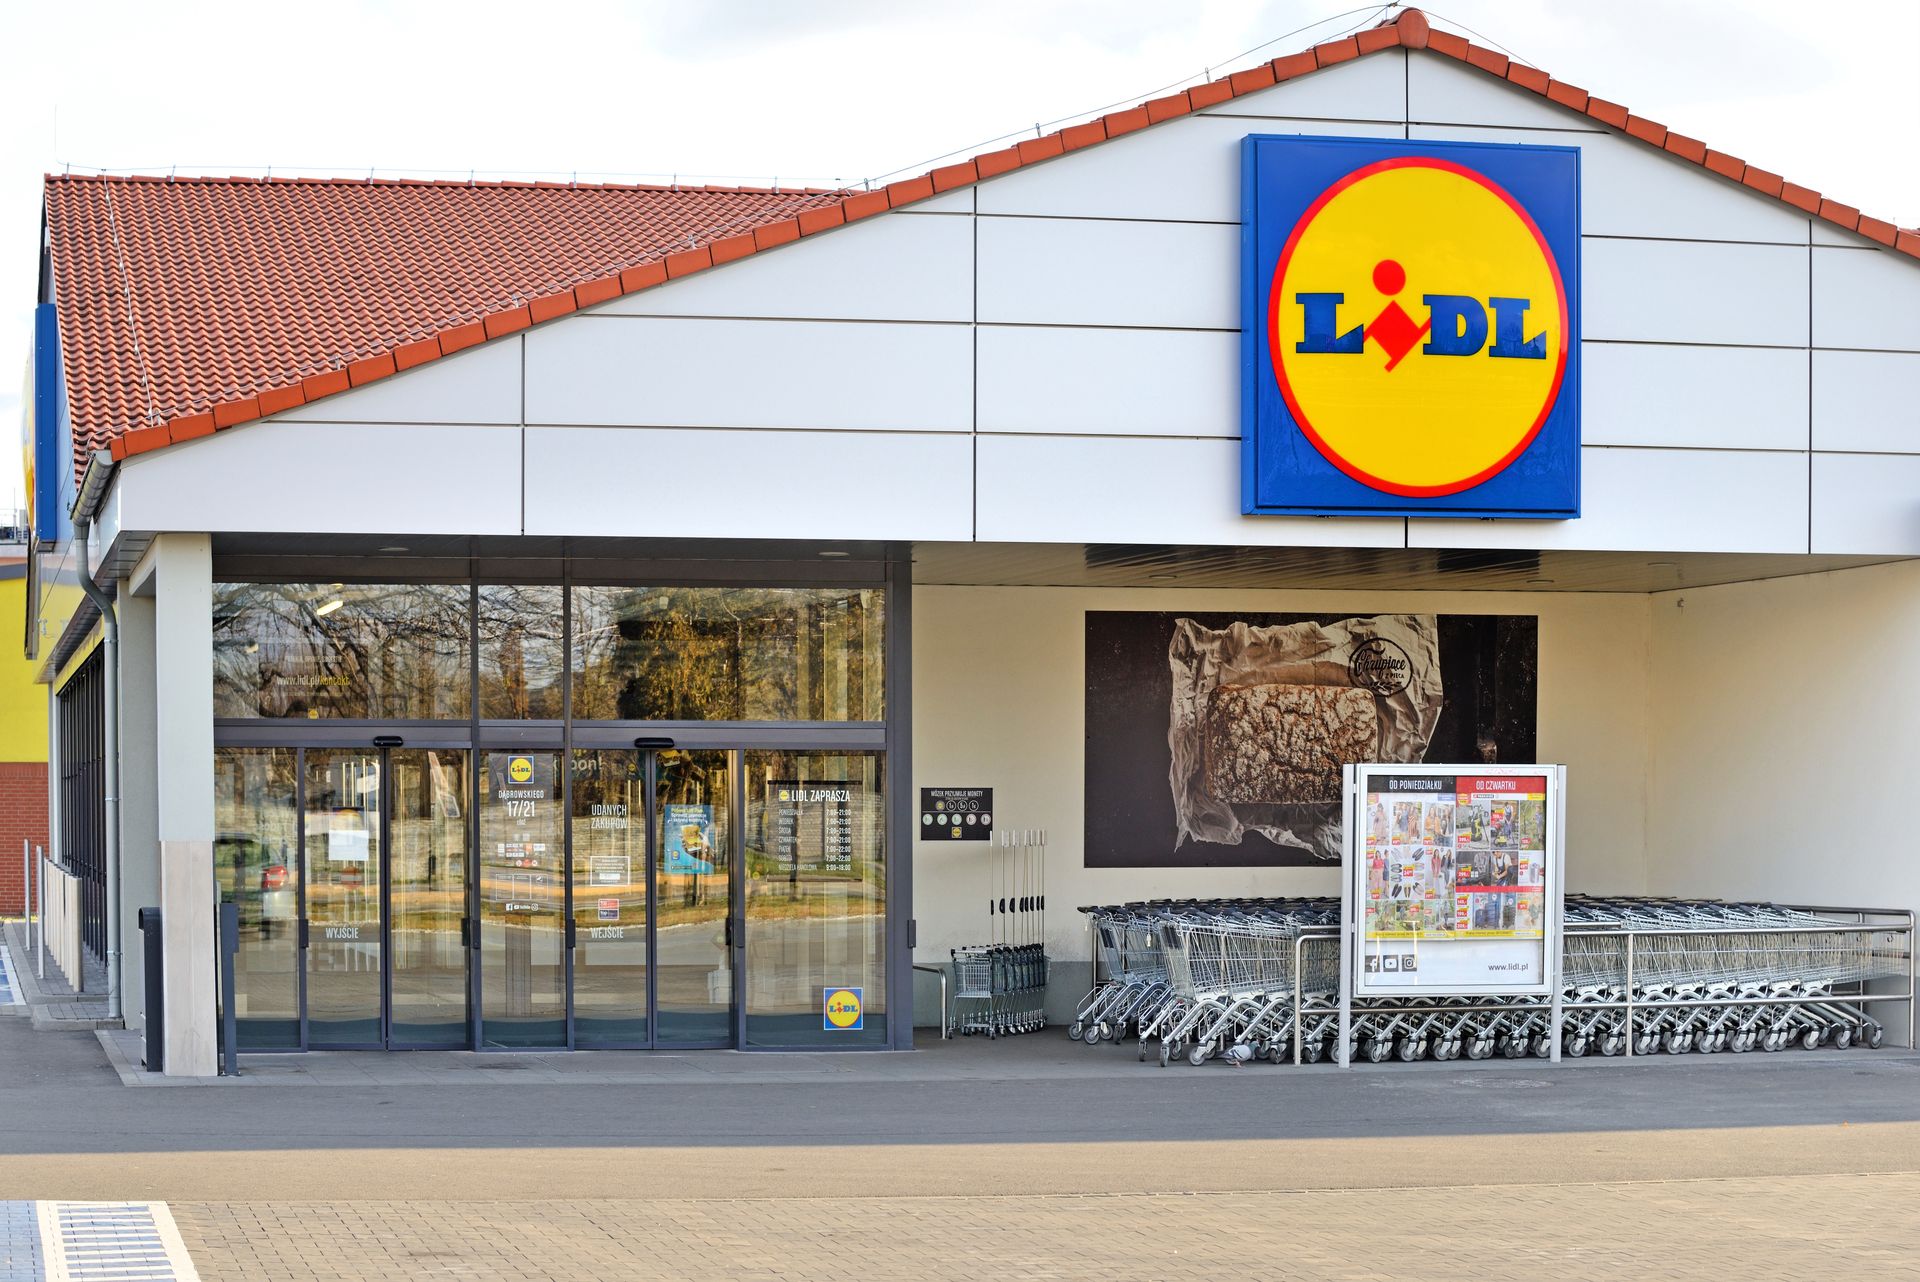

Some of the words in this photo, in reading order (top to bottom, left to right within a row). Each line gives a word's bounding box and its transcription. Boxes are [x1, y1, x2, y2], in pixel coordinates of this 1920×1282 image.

[1295, 259, 1547, 373] LIDL
[511, 765, 531, 774] LIDL
[1389, 780, 1398, 790] OD
[1399, 780, 1442, 790] PONIEDZIAŁKU
[1475, 780, 1485, 790] OD
[1485, 780, 1516, 791] CZWARTKU
[498, 790, 545, 800] DĄBROWSKIEGO
[791, 790, 809, 802] LIDL
[810, 790, 851, 802] ZAPRASZA
[507, 800, 536, 817] 17/21
[591, 804, 627, 816] UDANYCH
[591, 816, 628, 829] ZAKUPÓW
[325, 923, 359, 939] WYJŚCIE
[590, 925, 624, 939] WEJŚCIE
[1487, 962, 1529, 971] www.lidl.pl
[829, 1001, 859, 1015] LIDL
